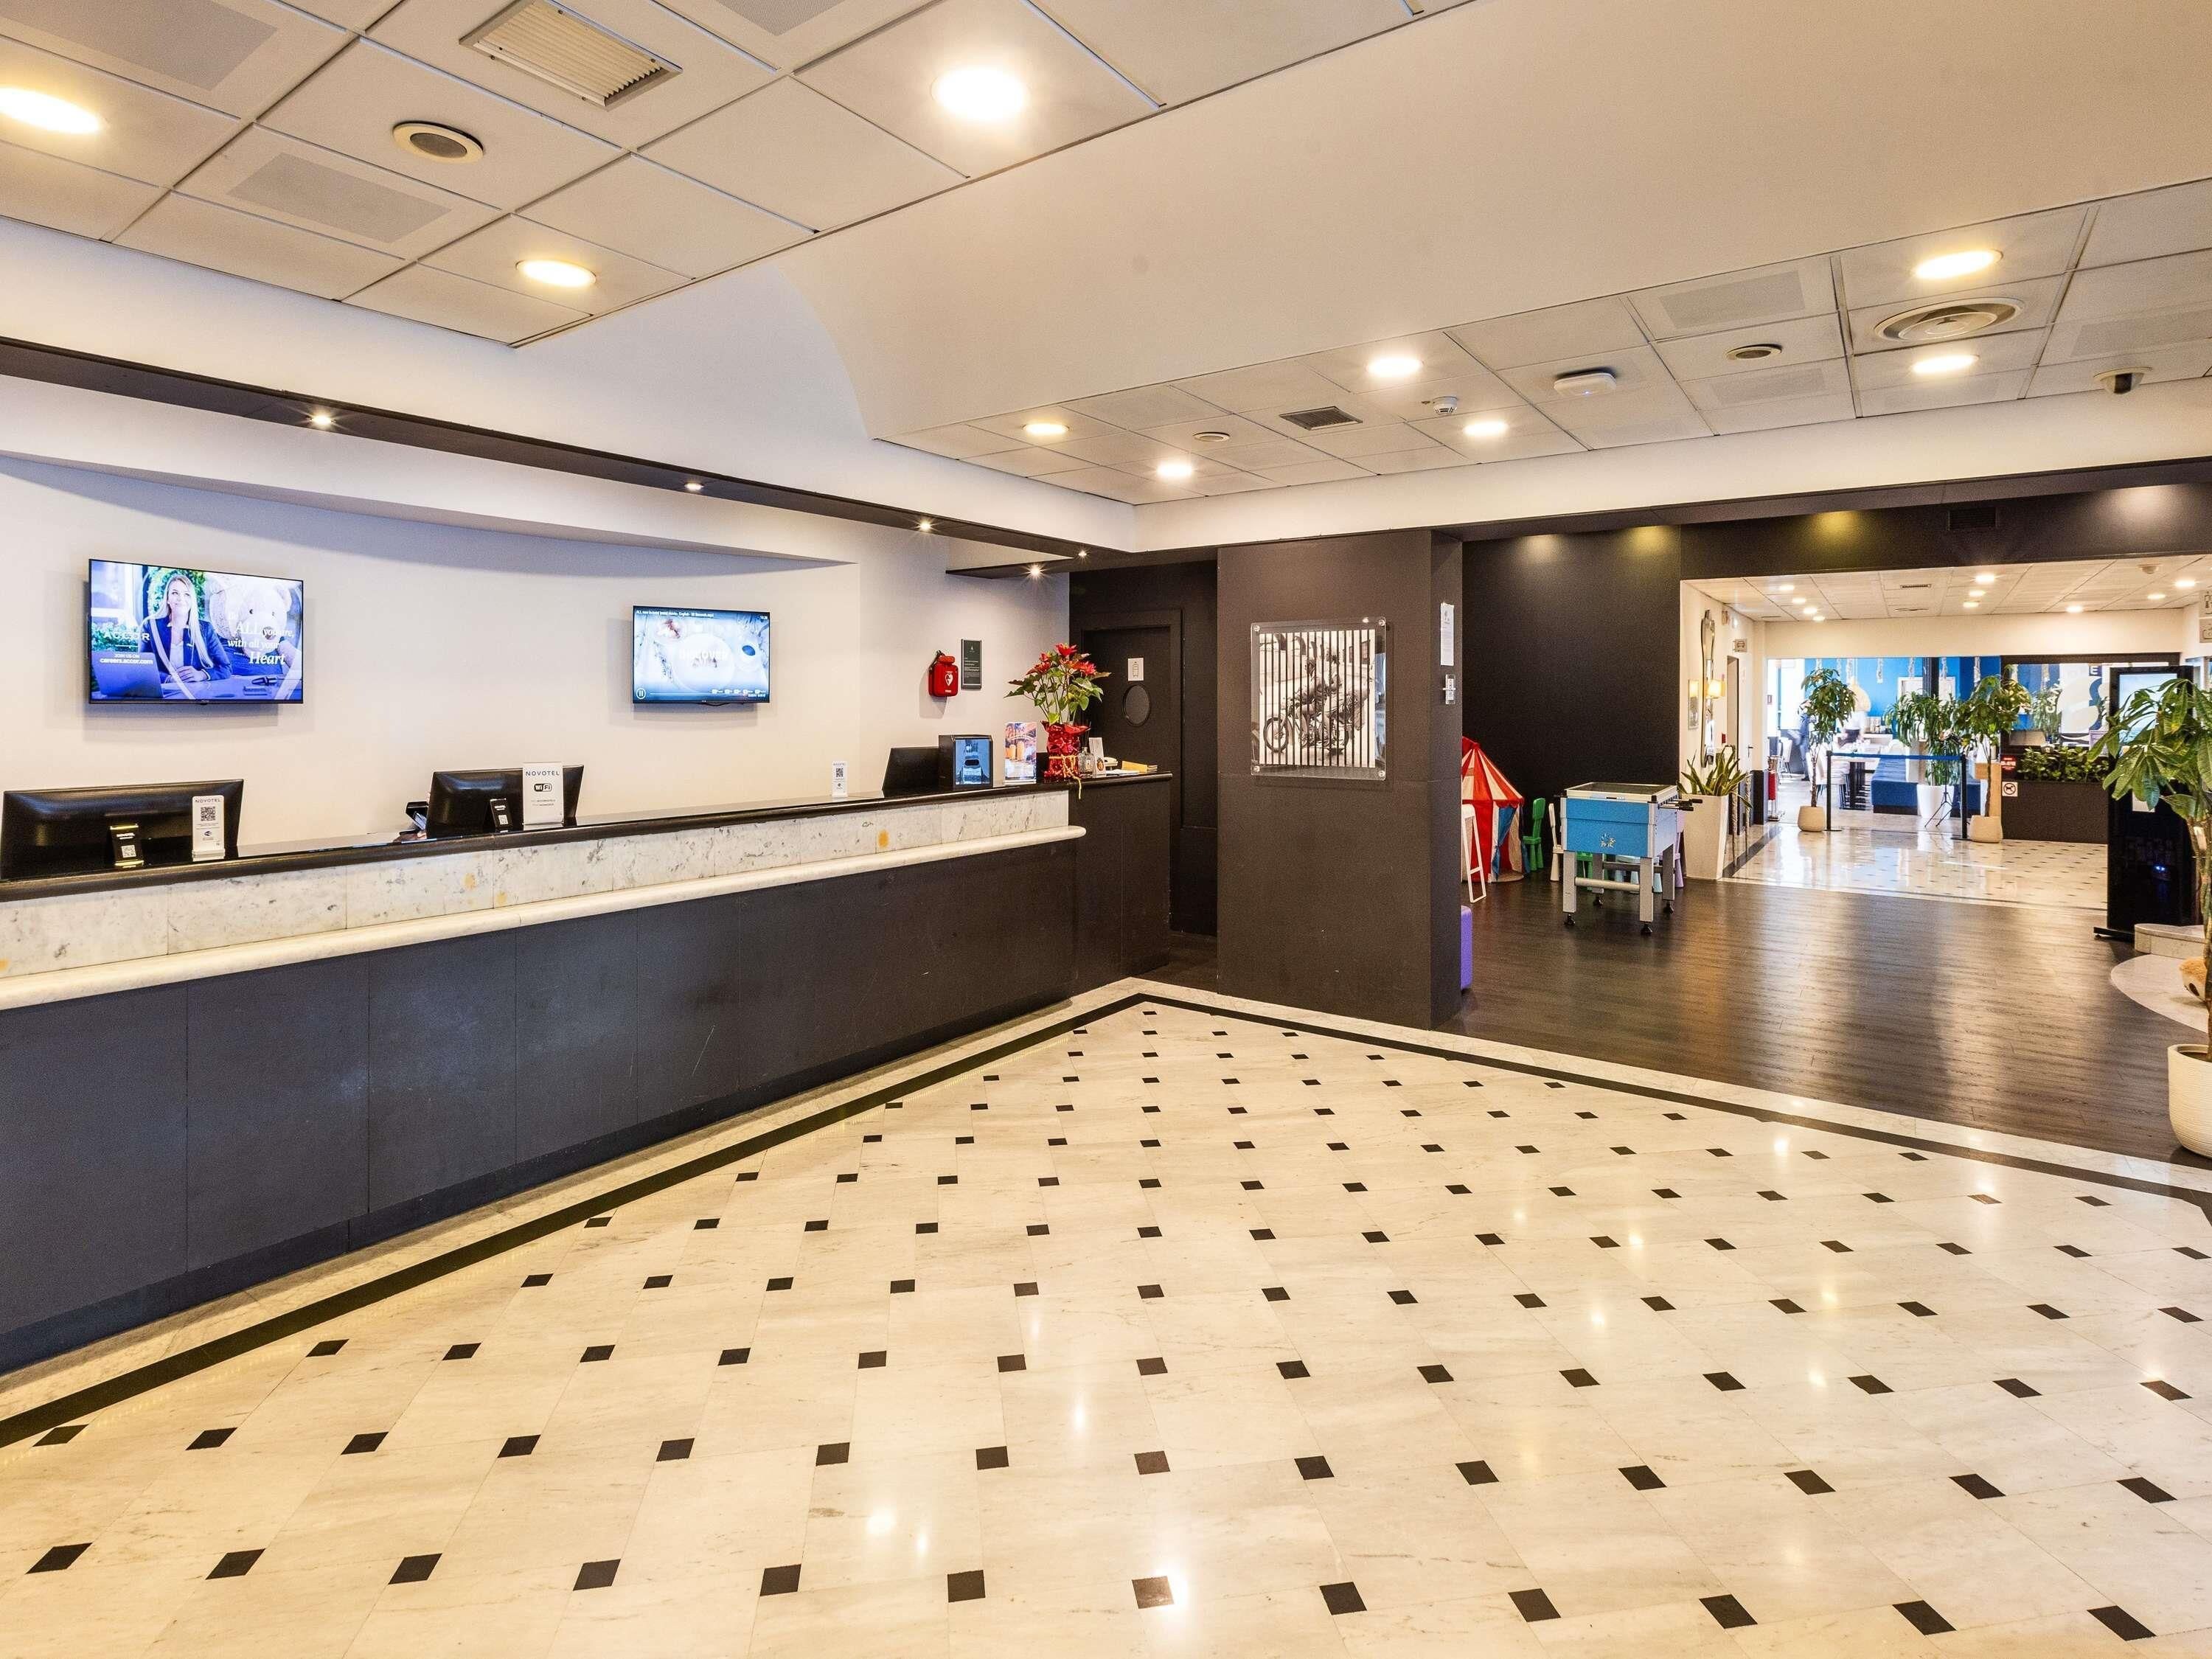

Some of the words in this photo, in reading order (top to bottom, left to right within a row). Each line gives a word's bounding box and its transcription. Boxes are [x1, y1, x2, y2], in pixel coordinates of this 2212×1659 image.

[103, 632, 150, 641] ACCOR
[228, 639, 246, 647] with
[248, 640, 260, 648] all
[248, 651, 285, 665] Heart
